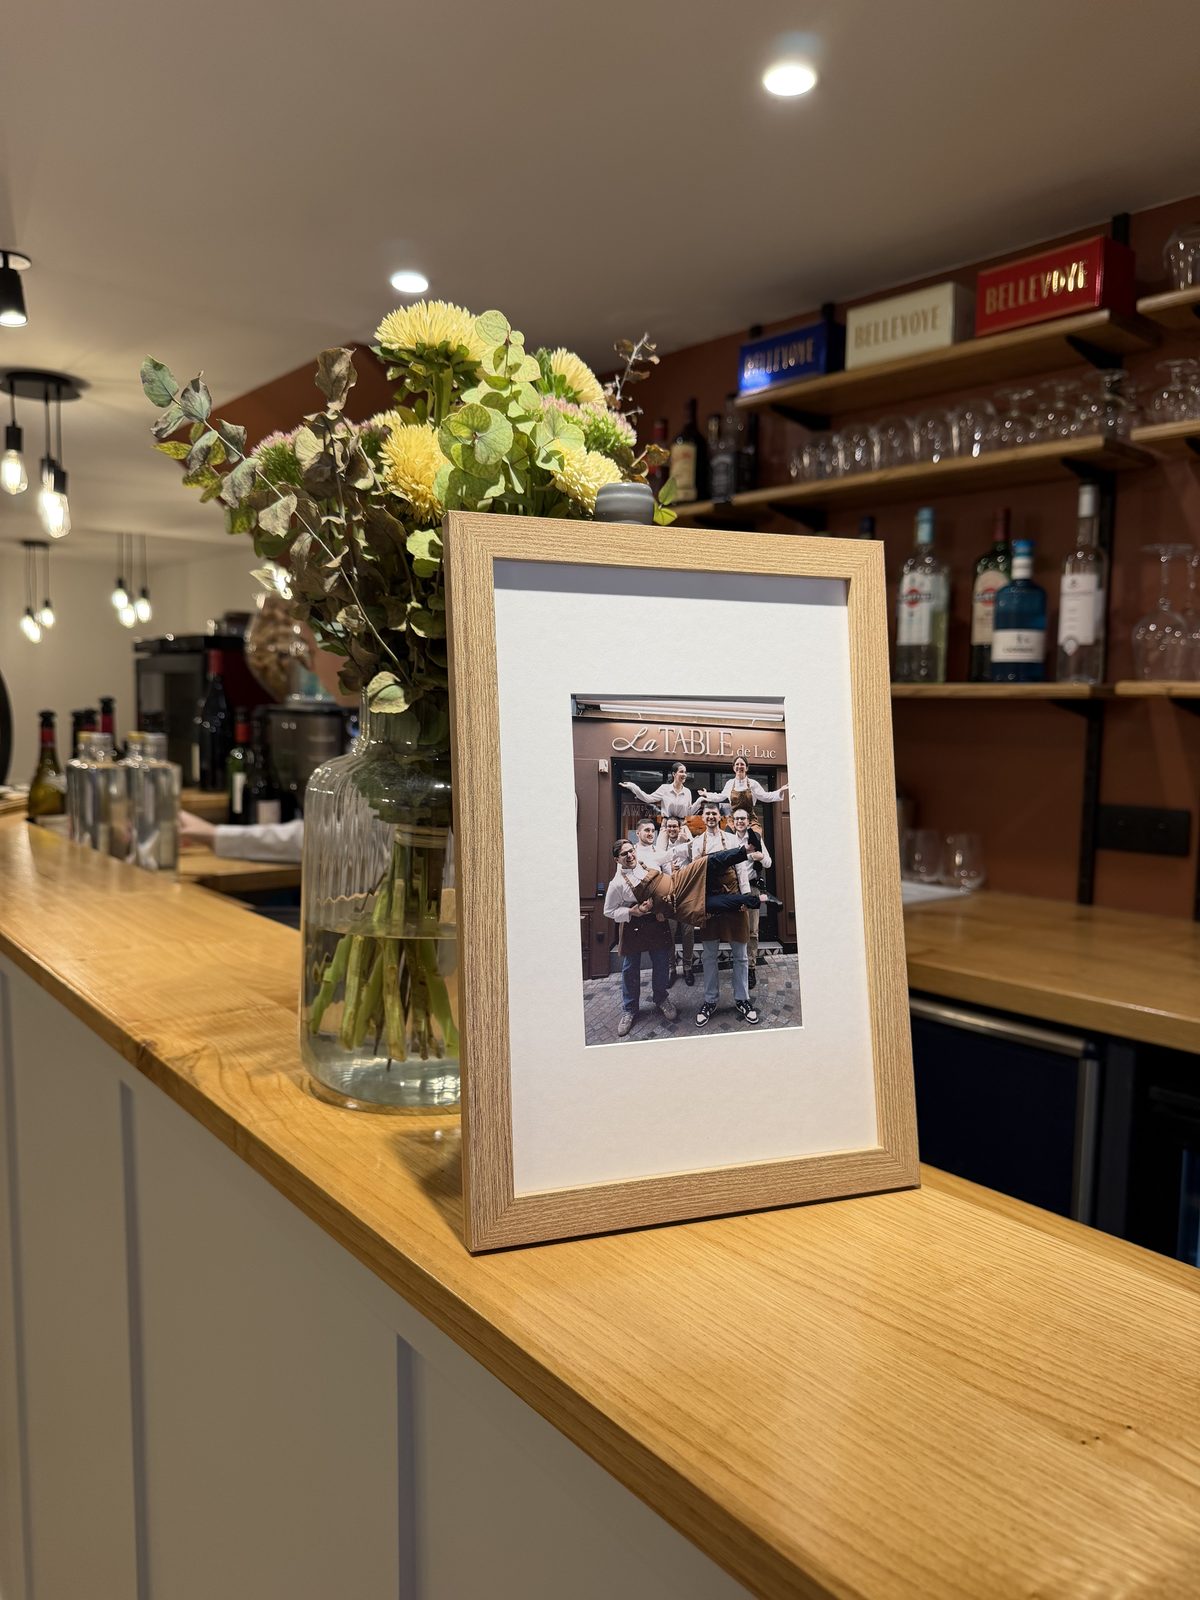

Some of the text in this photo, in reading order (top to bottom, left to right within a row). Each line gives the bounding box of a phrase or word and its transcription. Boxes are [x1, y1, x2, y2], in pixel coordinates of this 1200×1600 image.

[985, 260, 1088, 315] BELLEVOYE
[853, 305, 940, 349] BELLEVOYE
[613, 727, 776, 759] La TABLE de Luc
